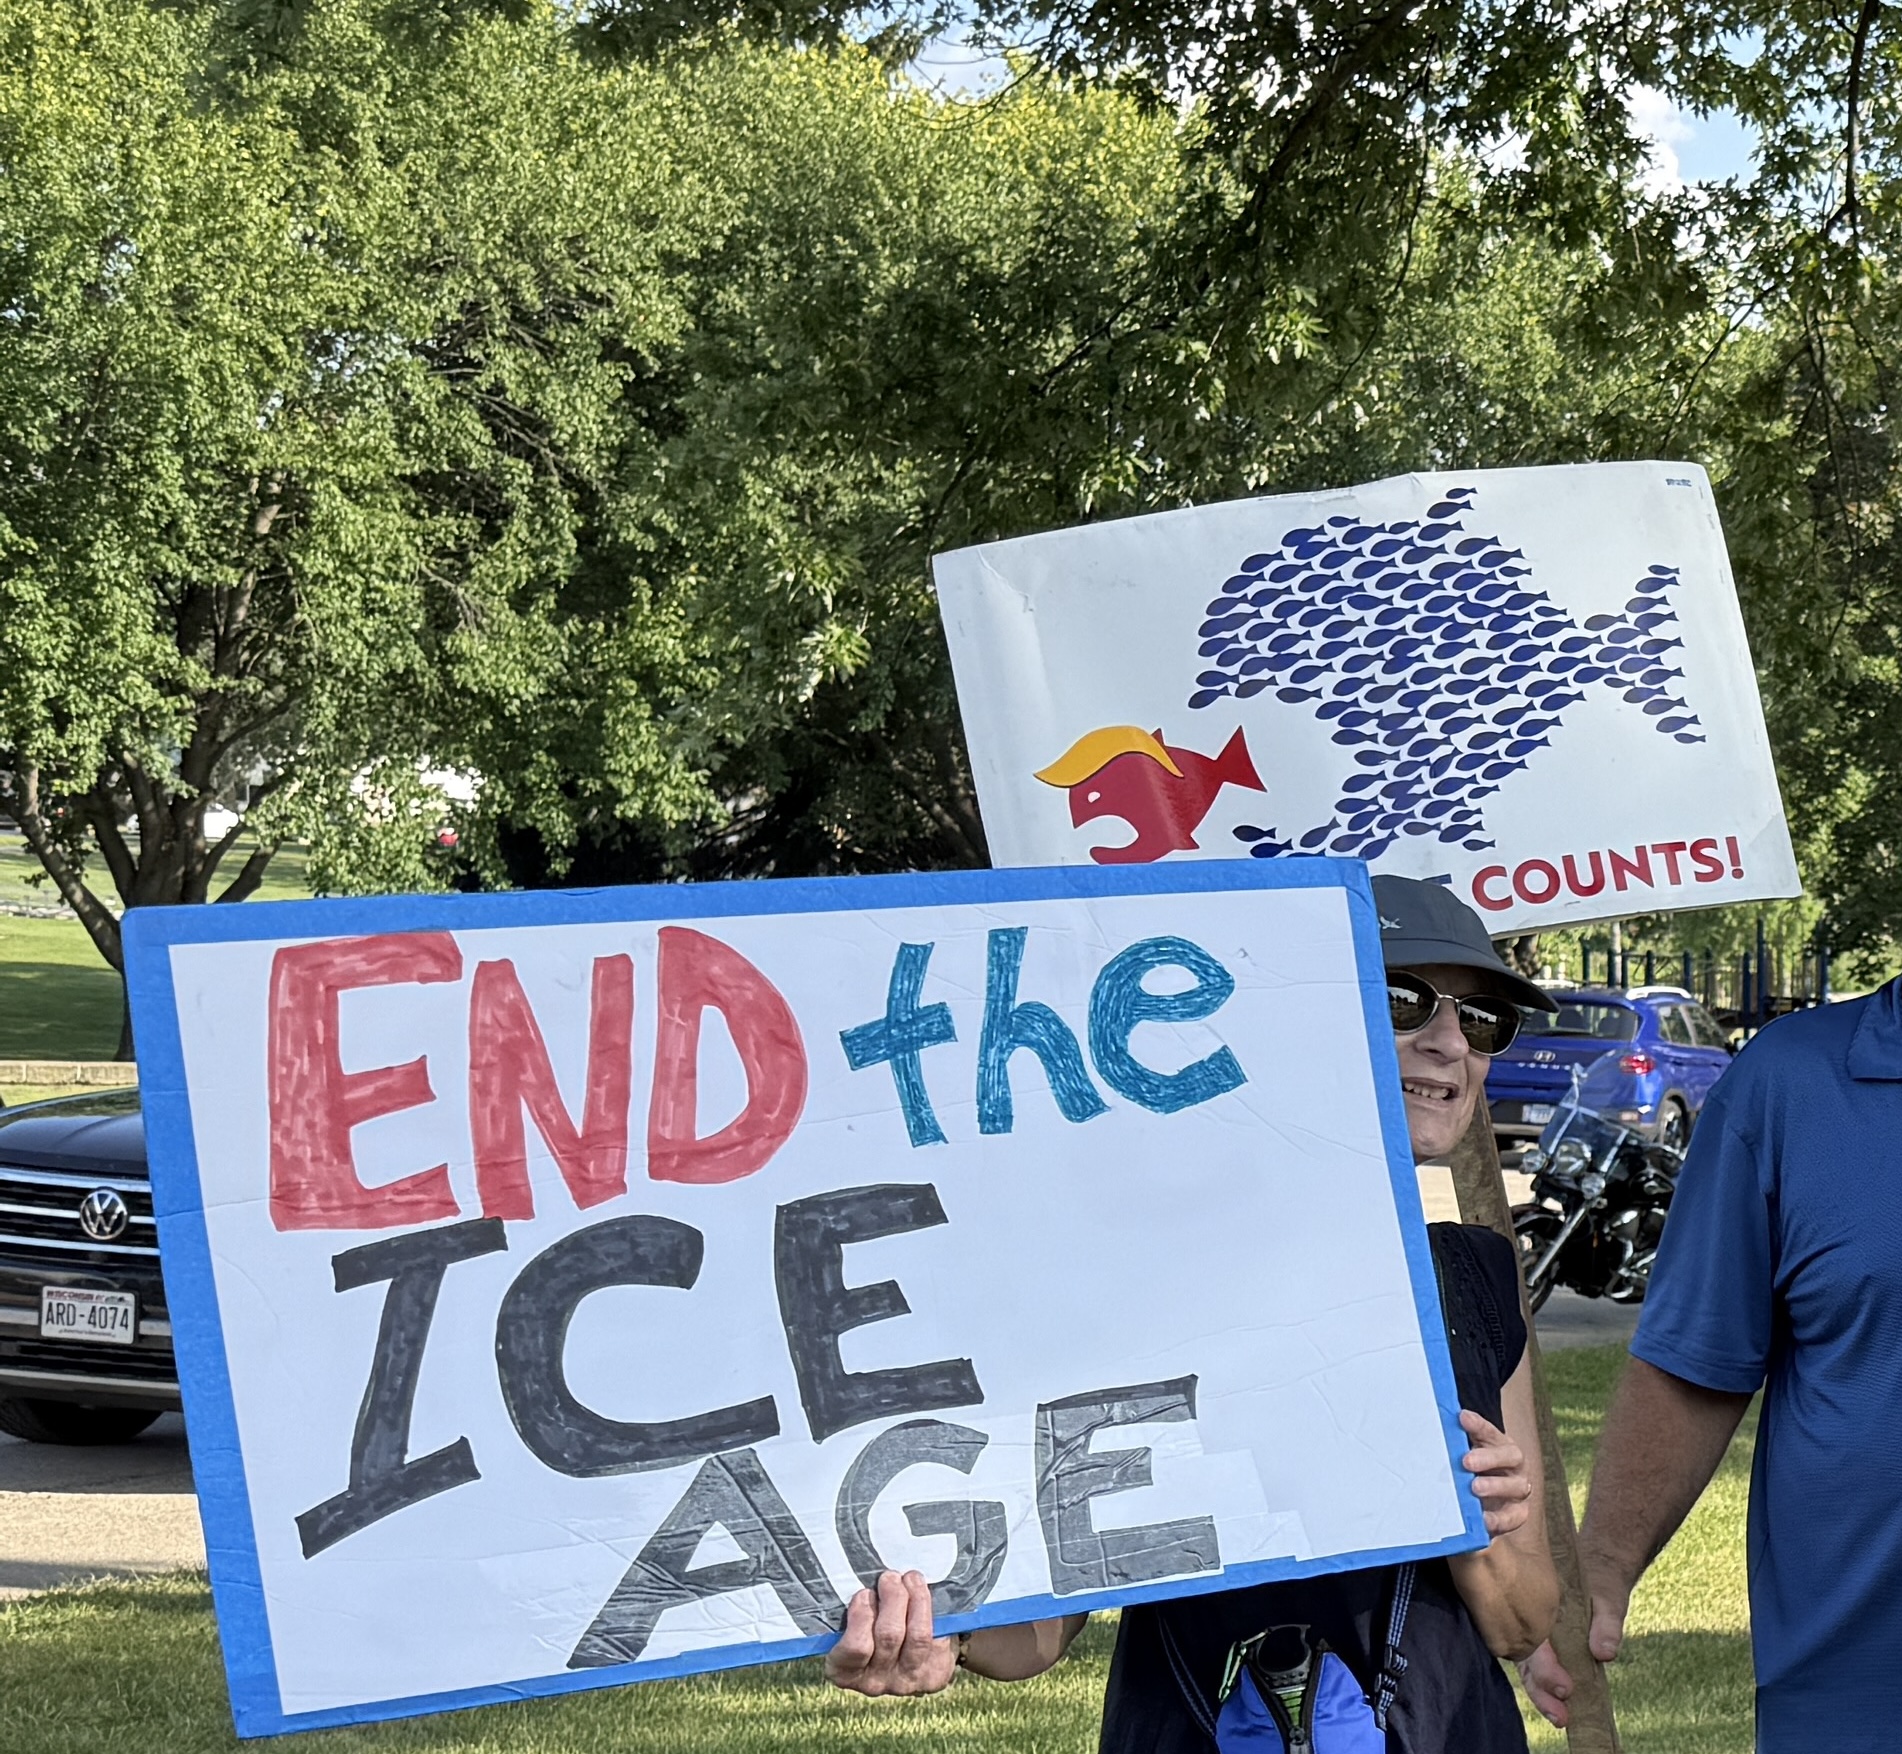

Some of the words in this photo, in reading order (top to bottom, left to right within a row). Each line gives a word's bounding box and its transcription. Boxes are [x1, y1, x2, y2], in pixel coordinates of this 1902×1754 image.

[1471, 835, 1744, 913] COUNTS!
[267, 926, 808, 1232] END
[838, 925, 1248, 1148] the
[46, 1301, 129, 1331] ARD-4074
[294, 1183, 985, 1559] ICE
[565, 1373, 1221, 1669] AGE
